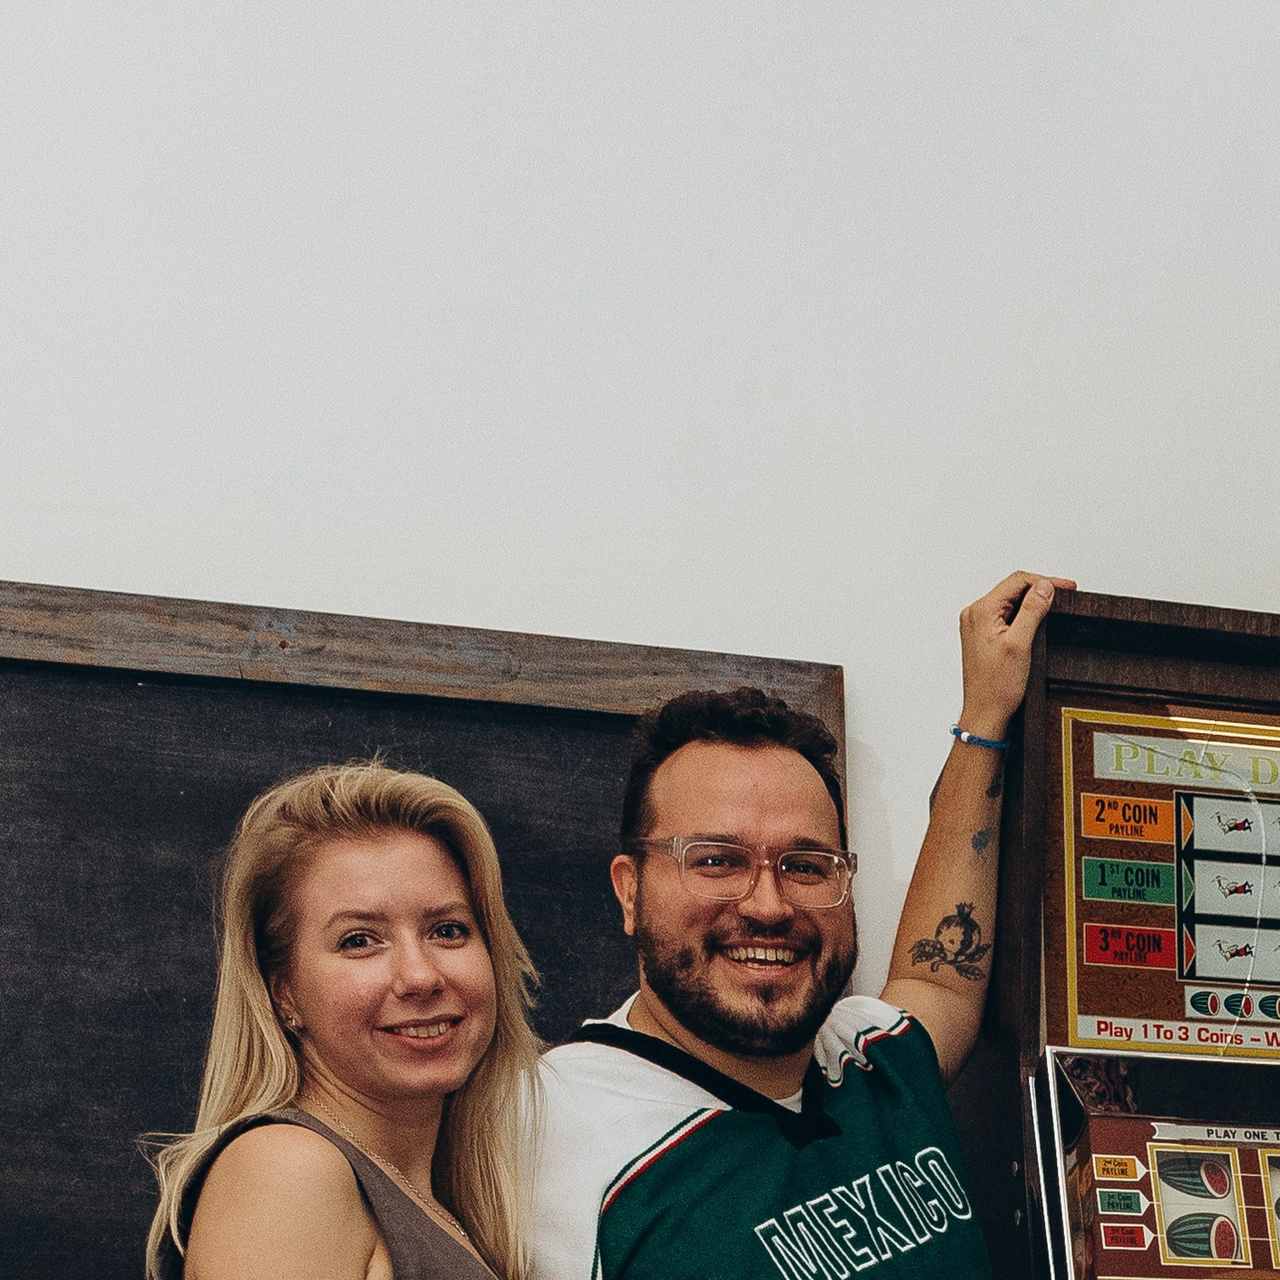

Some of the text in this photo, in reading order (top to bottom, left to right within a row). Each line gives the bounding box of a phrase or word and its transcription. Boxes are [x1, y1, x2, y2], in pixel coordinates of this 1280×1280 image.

[1112, 742, 1232, 780] PLAY
[1122, 803, 1158, 825] COIN
[1109, 823, 1145, 837] PAYLINE
[1124, 867, 1160, 888] COIN
[1112, 887, 1146, 900] PAYLINE
[1126, 932, 1162, 953] COIN
[1114, 951, 1147, 963] PAYLINE
[1096, 1020, 1133, 1042] Play
[1142, 1023, 1149, 1039] 1
[1153, 1024, 1174, 1040] To
[1178, 1026, 1190, 1041] 3
[1197, 1027, 1244, 1045] Coins
[1206, 1128, 1237, 1139] PLAY
[1243, 1130, 1268, 1141] ONE
[1102, 1168, 1129, 1176] PAYLINE
[1107, 1201, 1134, 1210] PAYLINE
